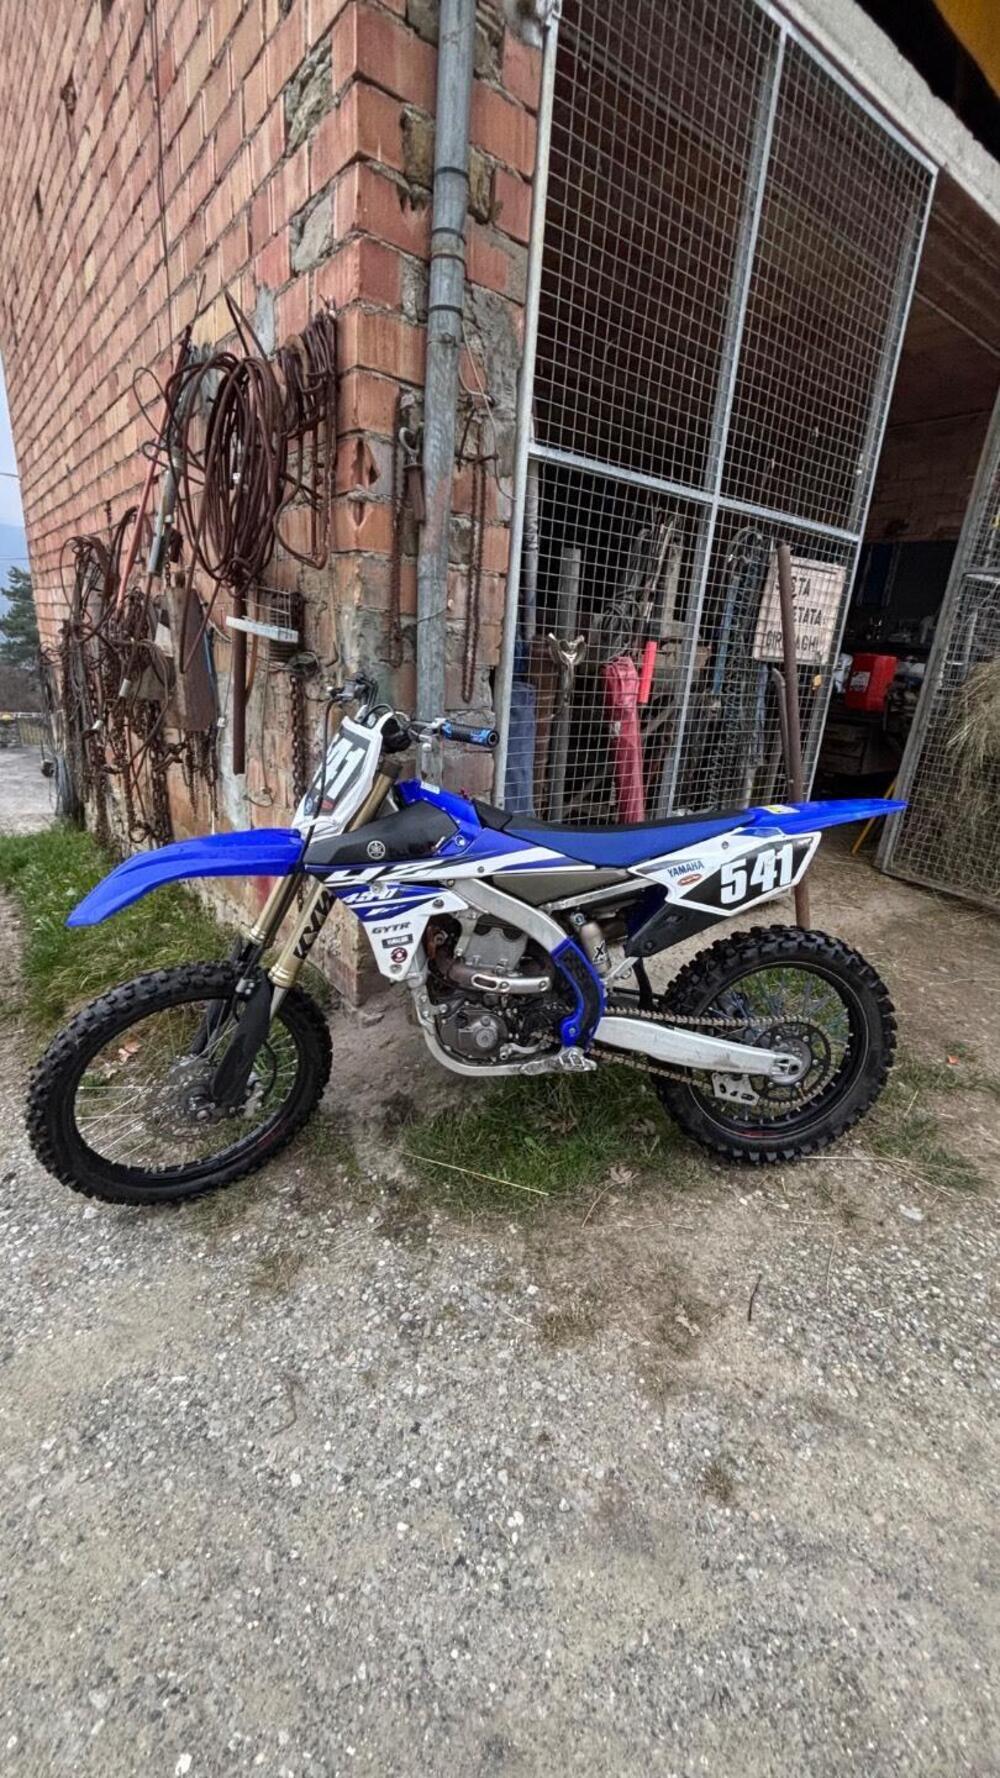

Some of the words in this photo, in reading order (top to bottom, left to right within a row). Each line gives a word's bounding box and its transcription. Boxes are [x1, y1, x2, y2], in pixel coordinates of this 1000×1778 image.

[314, 737, 366, 800] 41
[667, 860, 705, 878] YAMAHA
[720, 843, 793, 905] 541
[371, 921, 412, 934] GYTR
